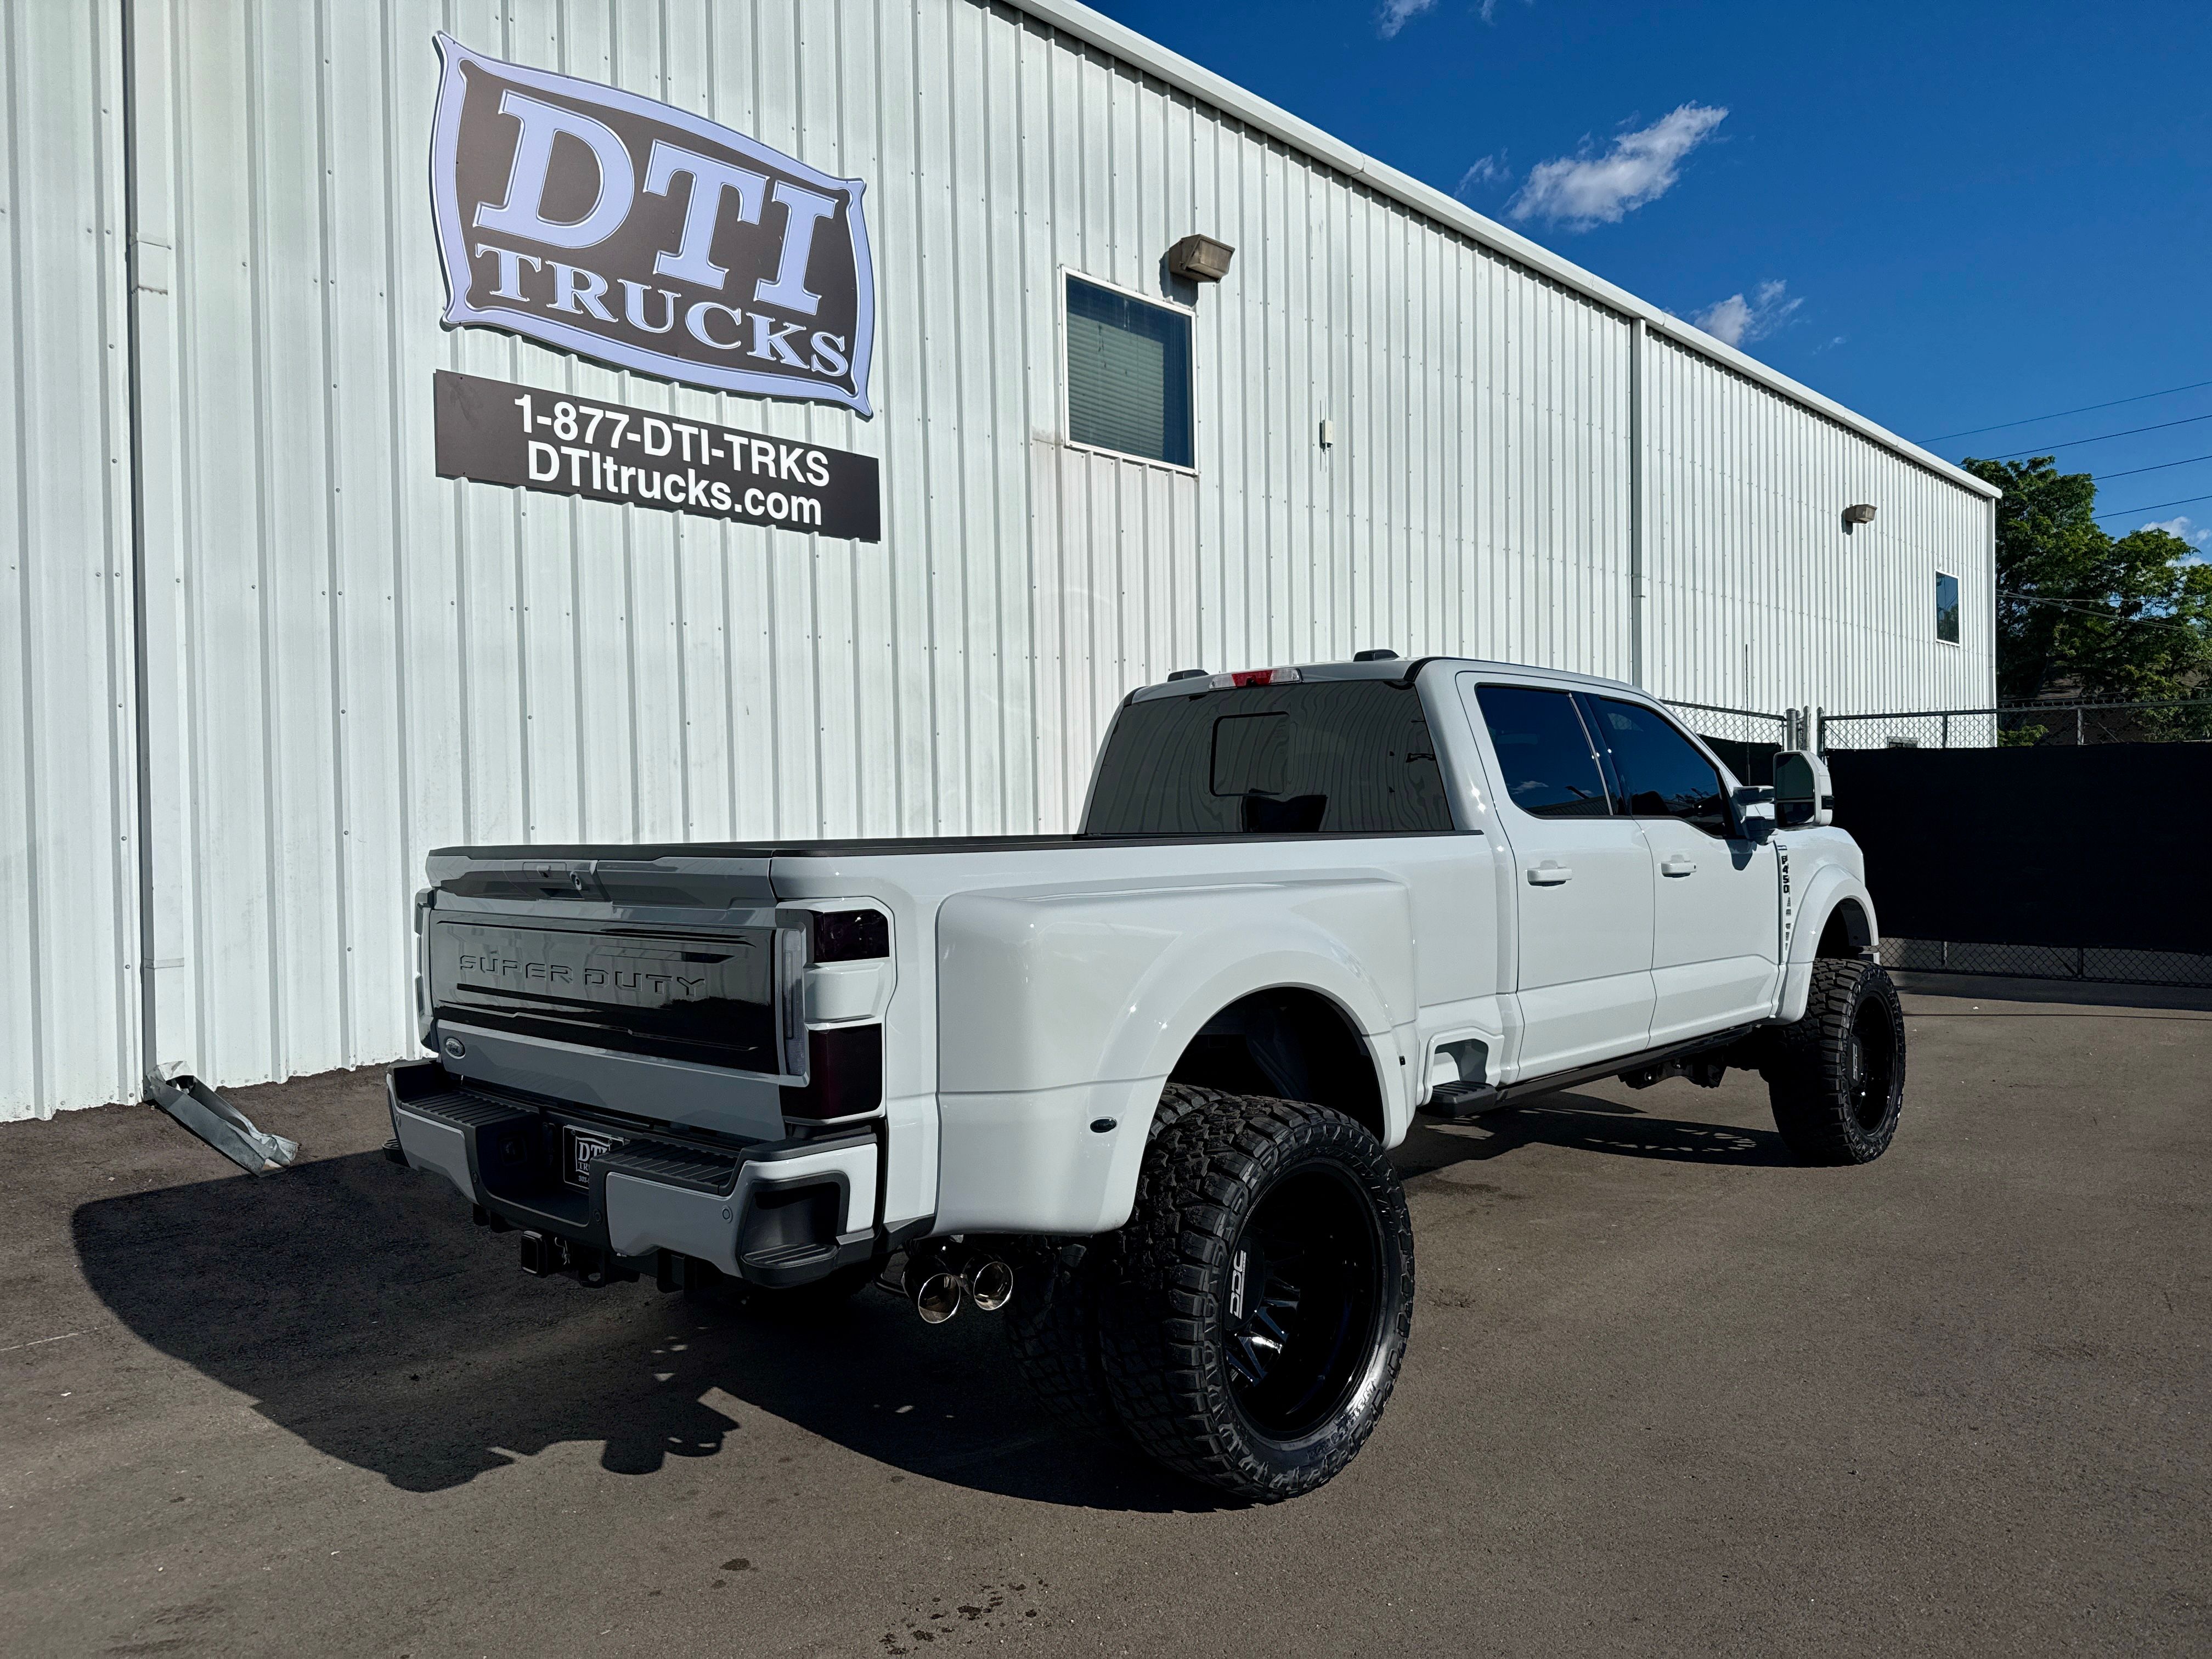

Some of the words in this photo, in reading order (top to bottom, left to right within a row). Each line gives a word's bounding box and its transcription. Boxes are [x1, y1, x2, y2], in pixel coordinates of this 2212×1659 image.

[473, 89, 839, 315] DTI
[475, 244, 848, 377] TRUCKS
[515, 393, 830, 487] 1-877-DTI-TRKS
[528, 441, 822, 526] DTItrucks.com
[460, 954, 573, 984] SUPER
[584, 967, 706, 997] DUTY
[1230, 1250, 1244, 1318] DDC
